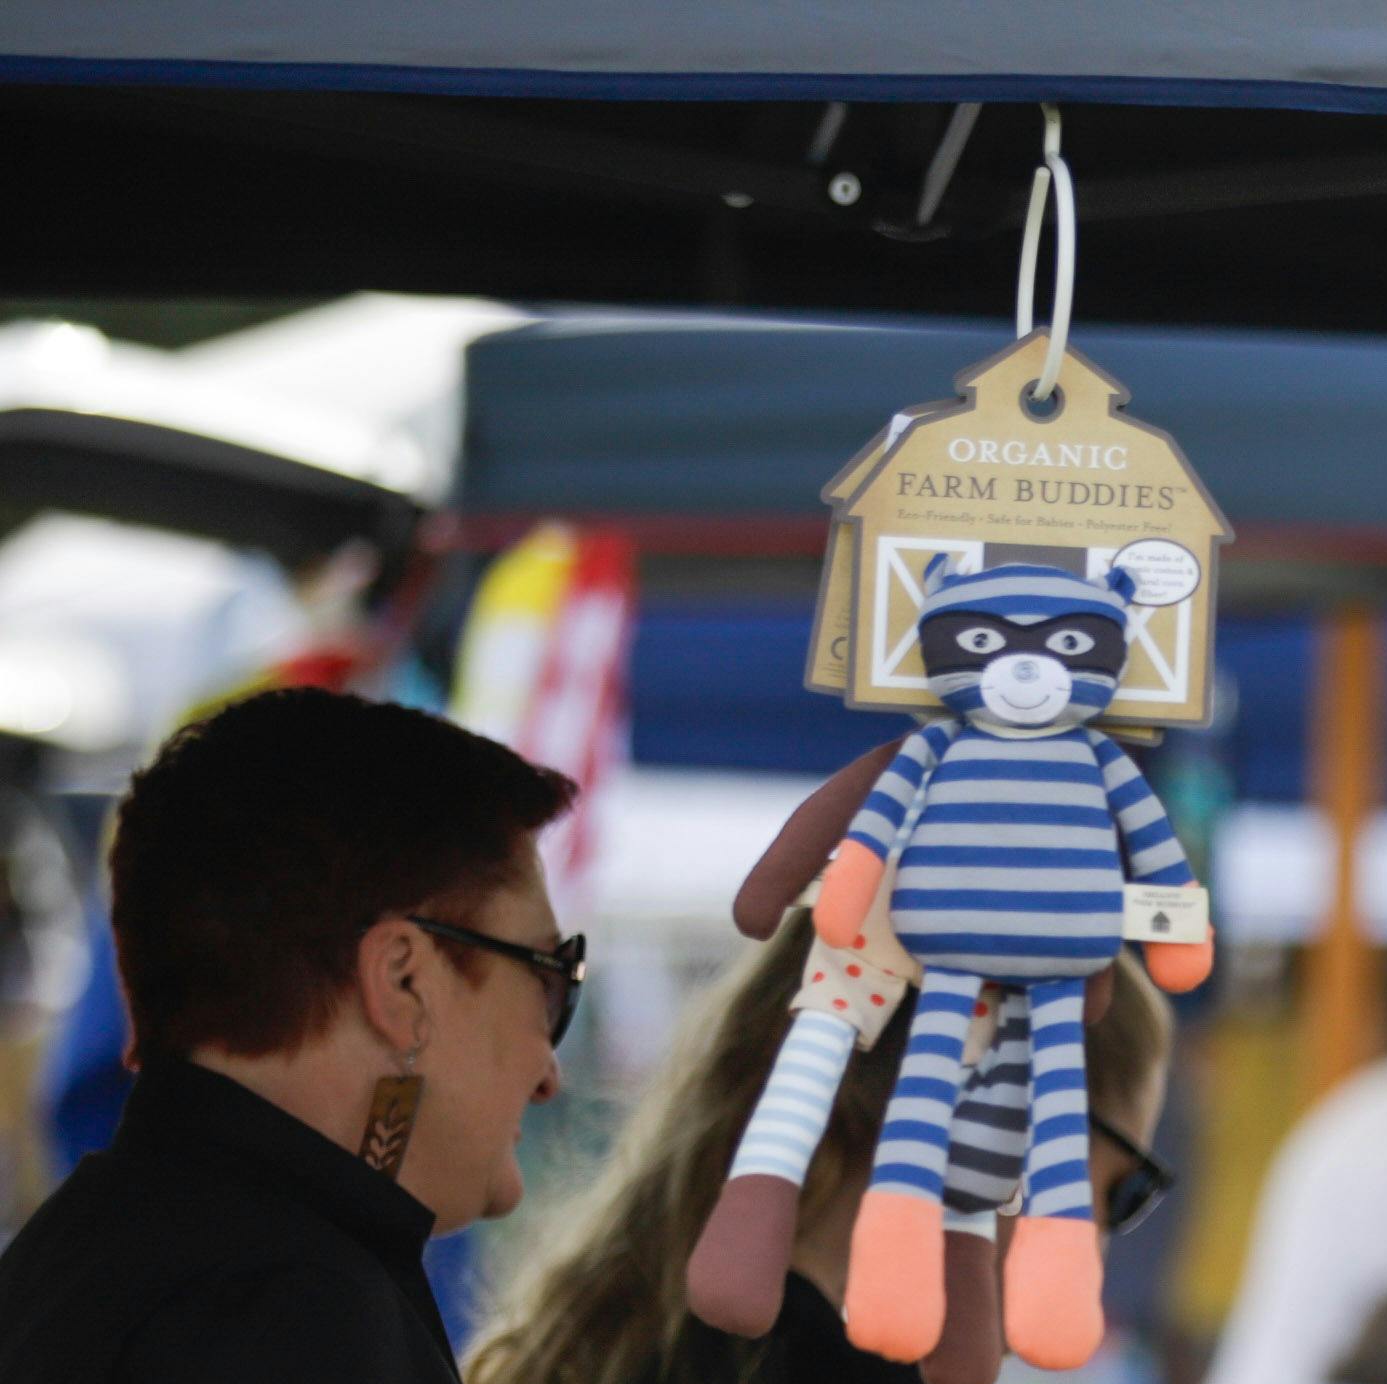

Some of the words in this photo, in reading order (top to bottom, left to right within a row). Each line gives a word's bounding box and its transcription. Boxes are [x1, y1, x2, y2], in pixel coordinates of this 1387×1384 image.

[949, 438, 1128, 471] ORGANIC
[896, 472, 998, 500] FARM
[896, 508, 977, 526] Eco-Friendly
[986, 513, 1011, 526] Safe
[1014, 514, 1032, 527] for
[1036, 515, 1075, 529] Babies
[1085, 518, 1140, 534] Polyester
